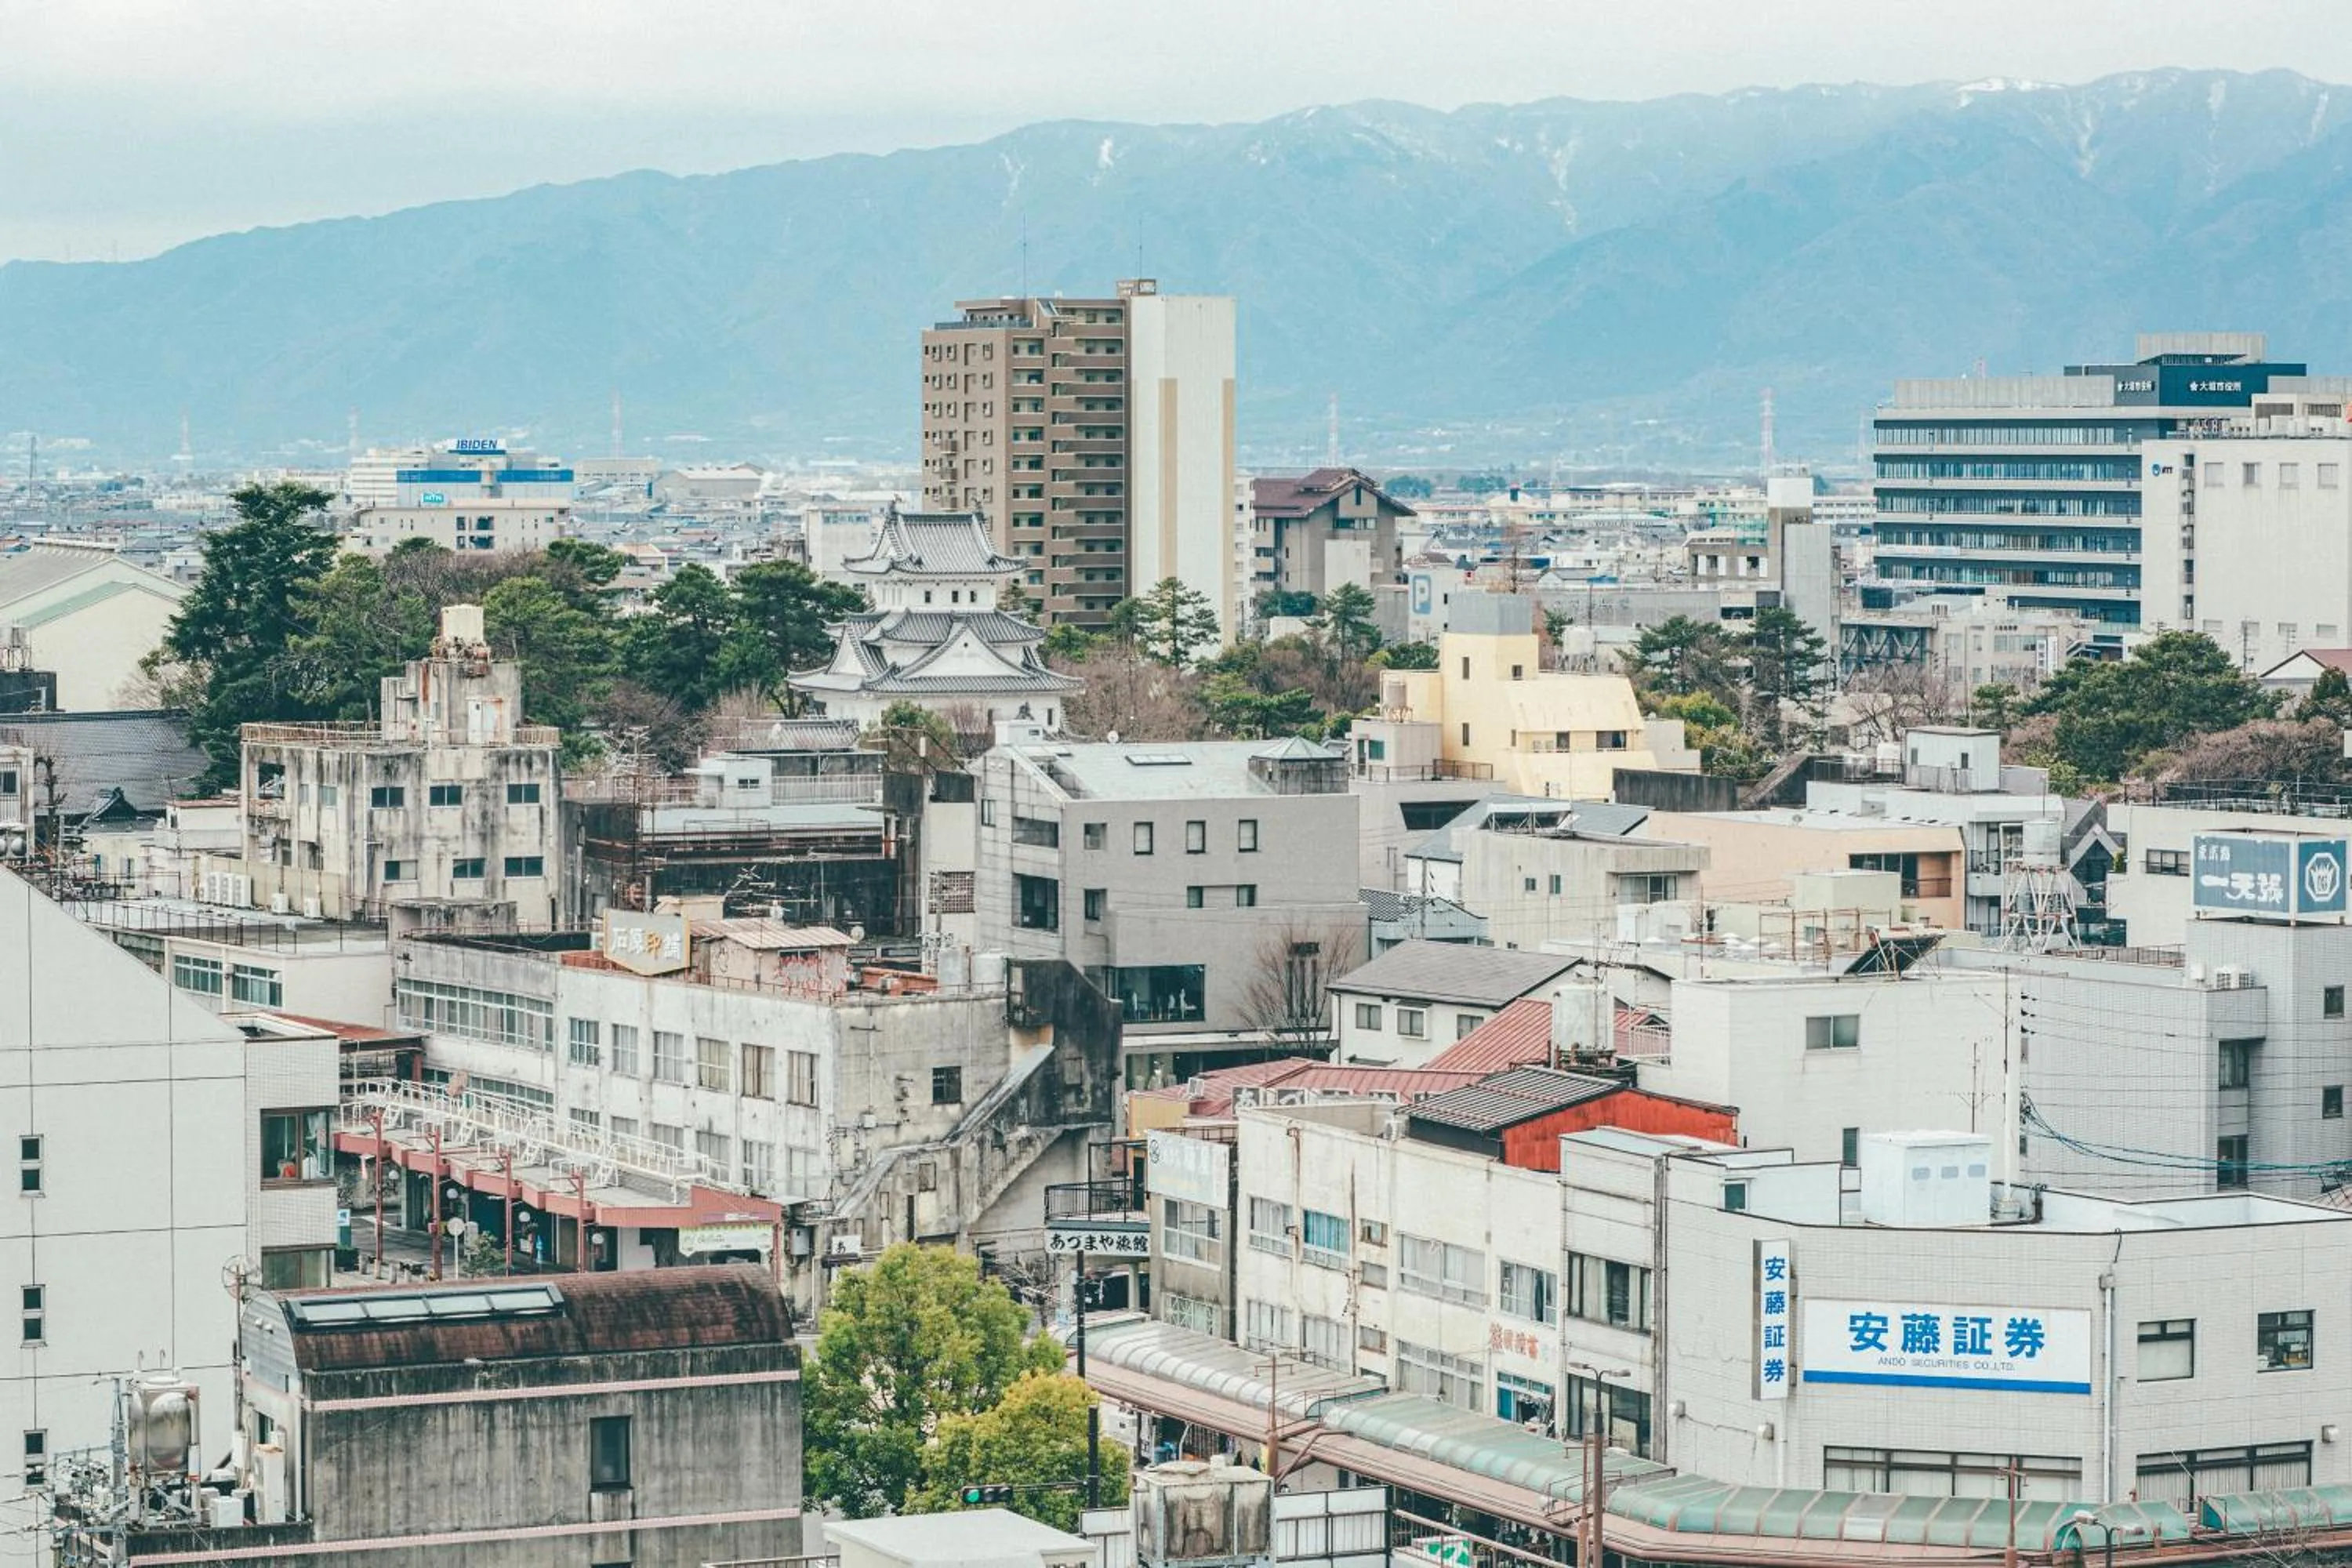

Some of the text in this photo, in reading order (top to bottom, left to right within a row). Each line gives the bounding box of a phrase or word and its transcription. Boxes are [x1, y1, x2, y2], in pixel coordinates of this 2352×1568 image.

[456, 439, 498, 449] IBIDEN
[1051, 1233, 1149, 1252] あづまや旅館
[1764, 1256, 1785, 1383] 安藤証券
[1849, 1312, 2045, 1358] 安藤証券
[1878, 1357, 1906, 1367] ANDO
[1911, 1358, 1969, 1370] SECURITIES
